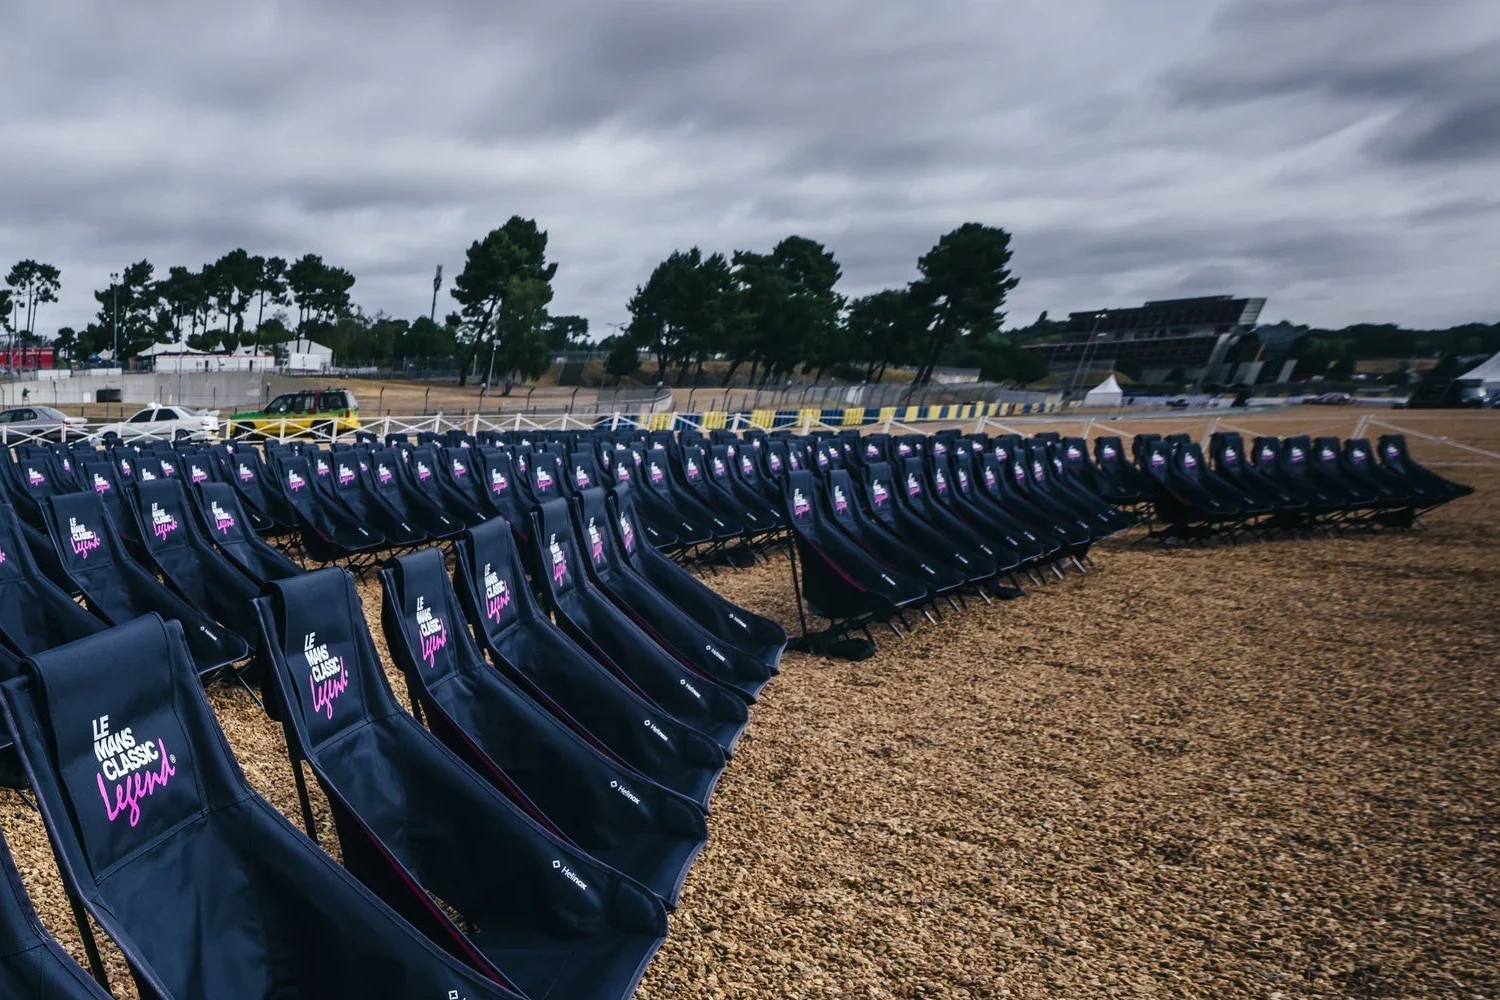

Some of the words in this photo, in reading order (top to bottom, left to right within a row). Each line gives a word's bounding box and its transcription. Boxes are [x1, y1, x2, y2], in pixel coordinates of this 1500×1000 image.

[416, 596, 424, 612] LE
[304, 632, 316, 652] LE
[304, 644, 330, 667] MANS
[312, 656, 340, 683] CLASSIC
[92, 714, 110, 741] LE
[94, 727, 136, 763] MANS
[102, 740, 159, 781] CLASSIC
[561, 866, 588, 891] Helinox
